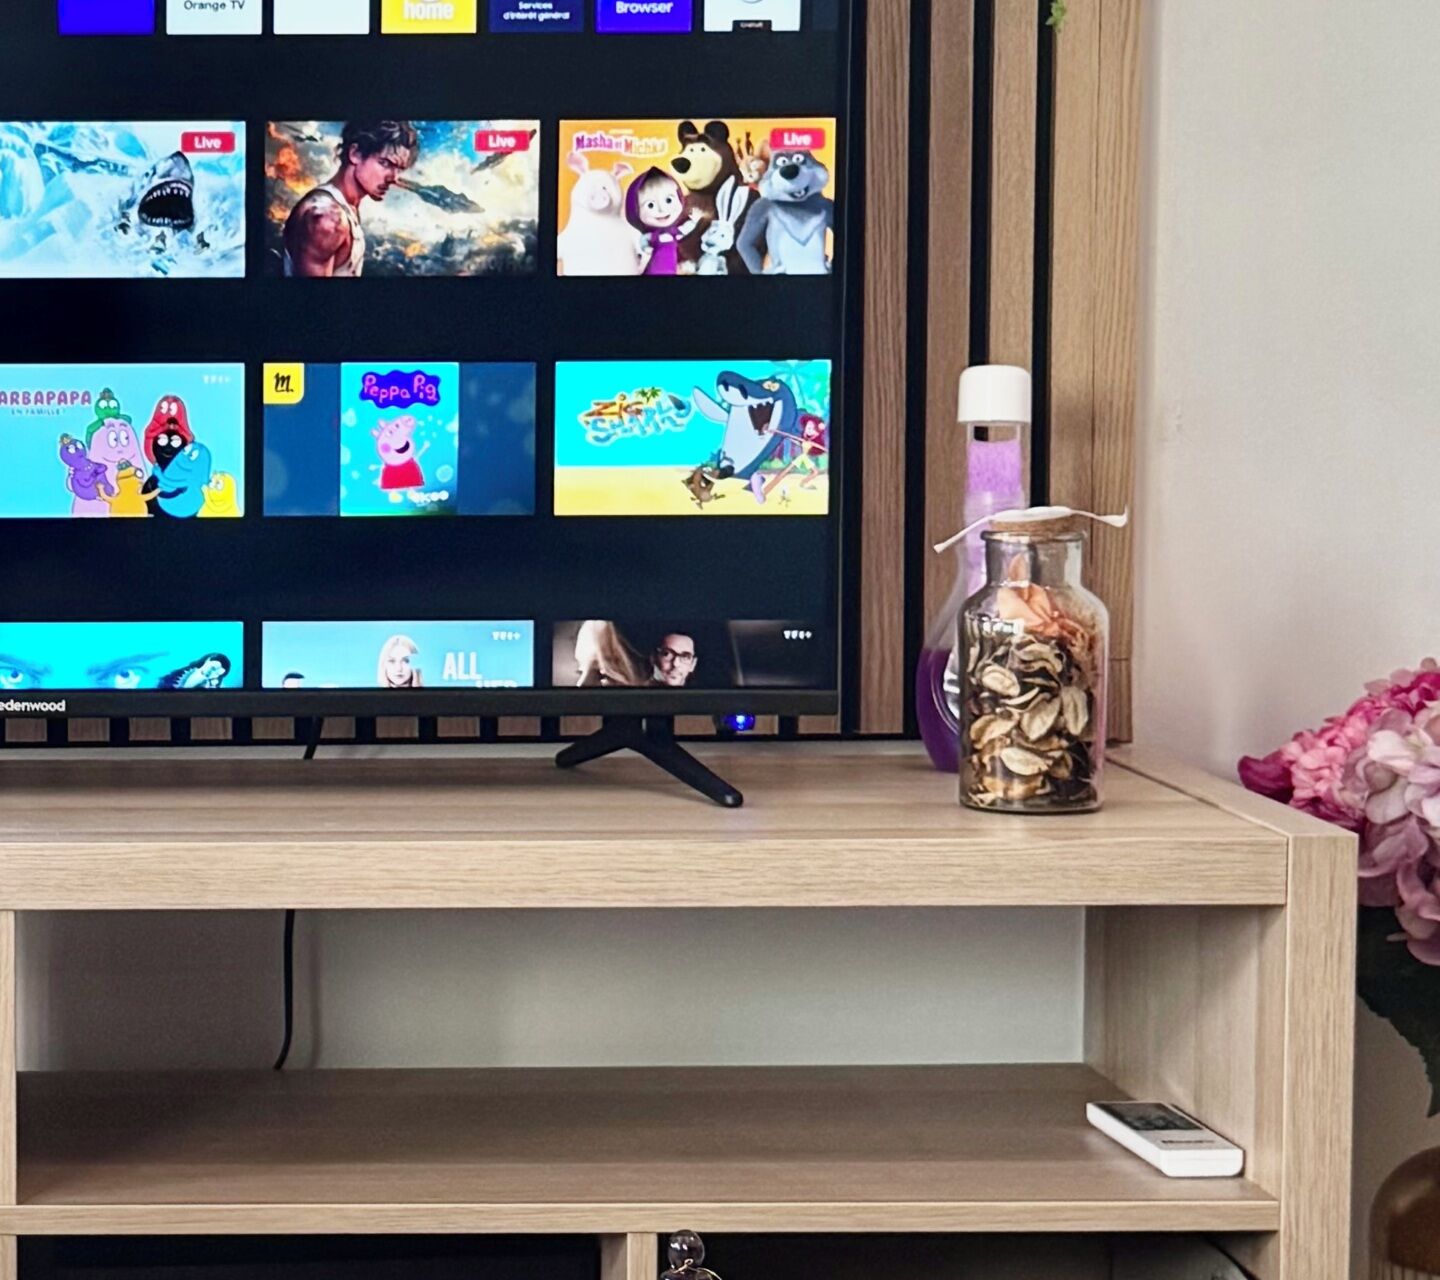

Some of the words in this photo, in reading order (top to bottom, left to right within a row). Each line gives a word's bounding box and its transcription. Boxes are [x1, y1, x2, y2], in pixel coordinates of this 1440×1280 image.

[184, 0, 227, 12] Orange
[230, 0, 245, 10] TV
[616, 1, 674, 13] Browser
[194, 135, 221, 149] Live
[488, 134, 515, 148] Live
[783, 132, 812, 146] Live
[364, 374, 411, 403] Peppa
[413, 374, 438, 401] Pig
[442, 650, 483, 681] ALL
